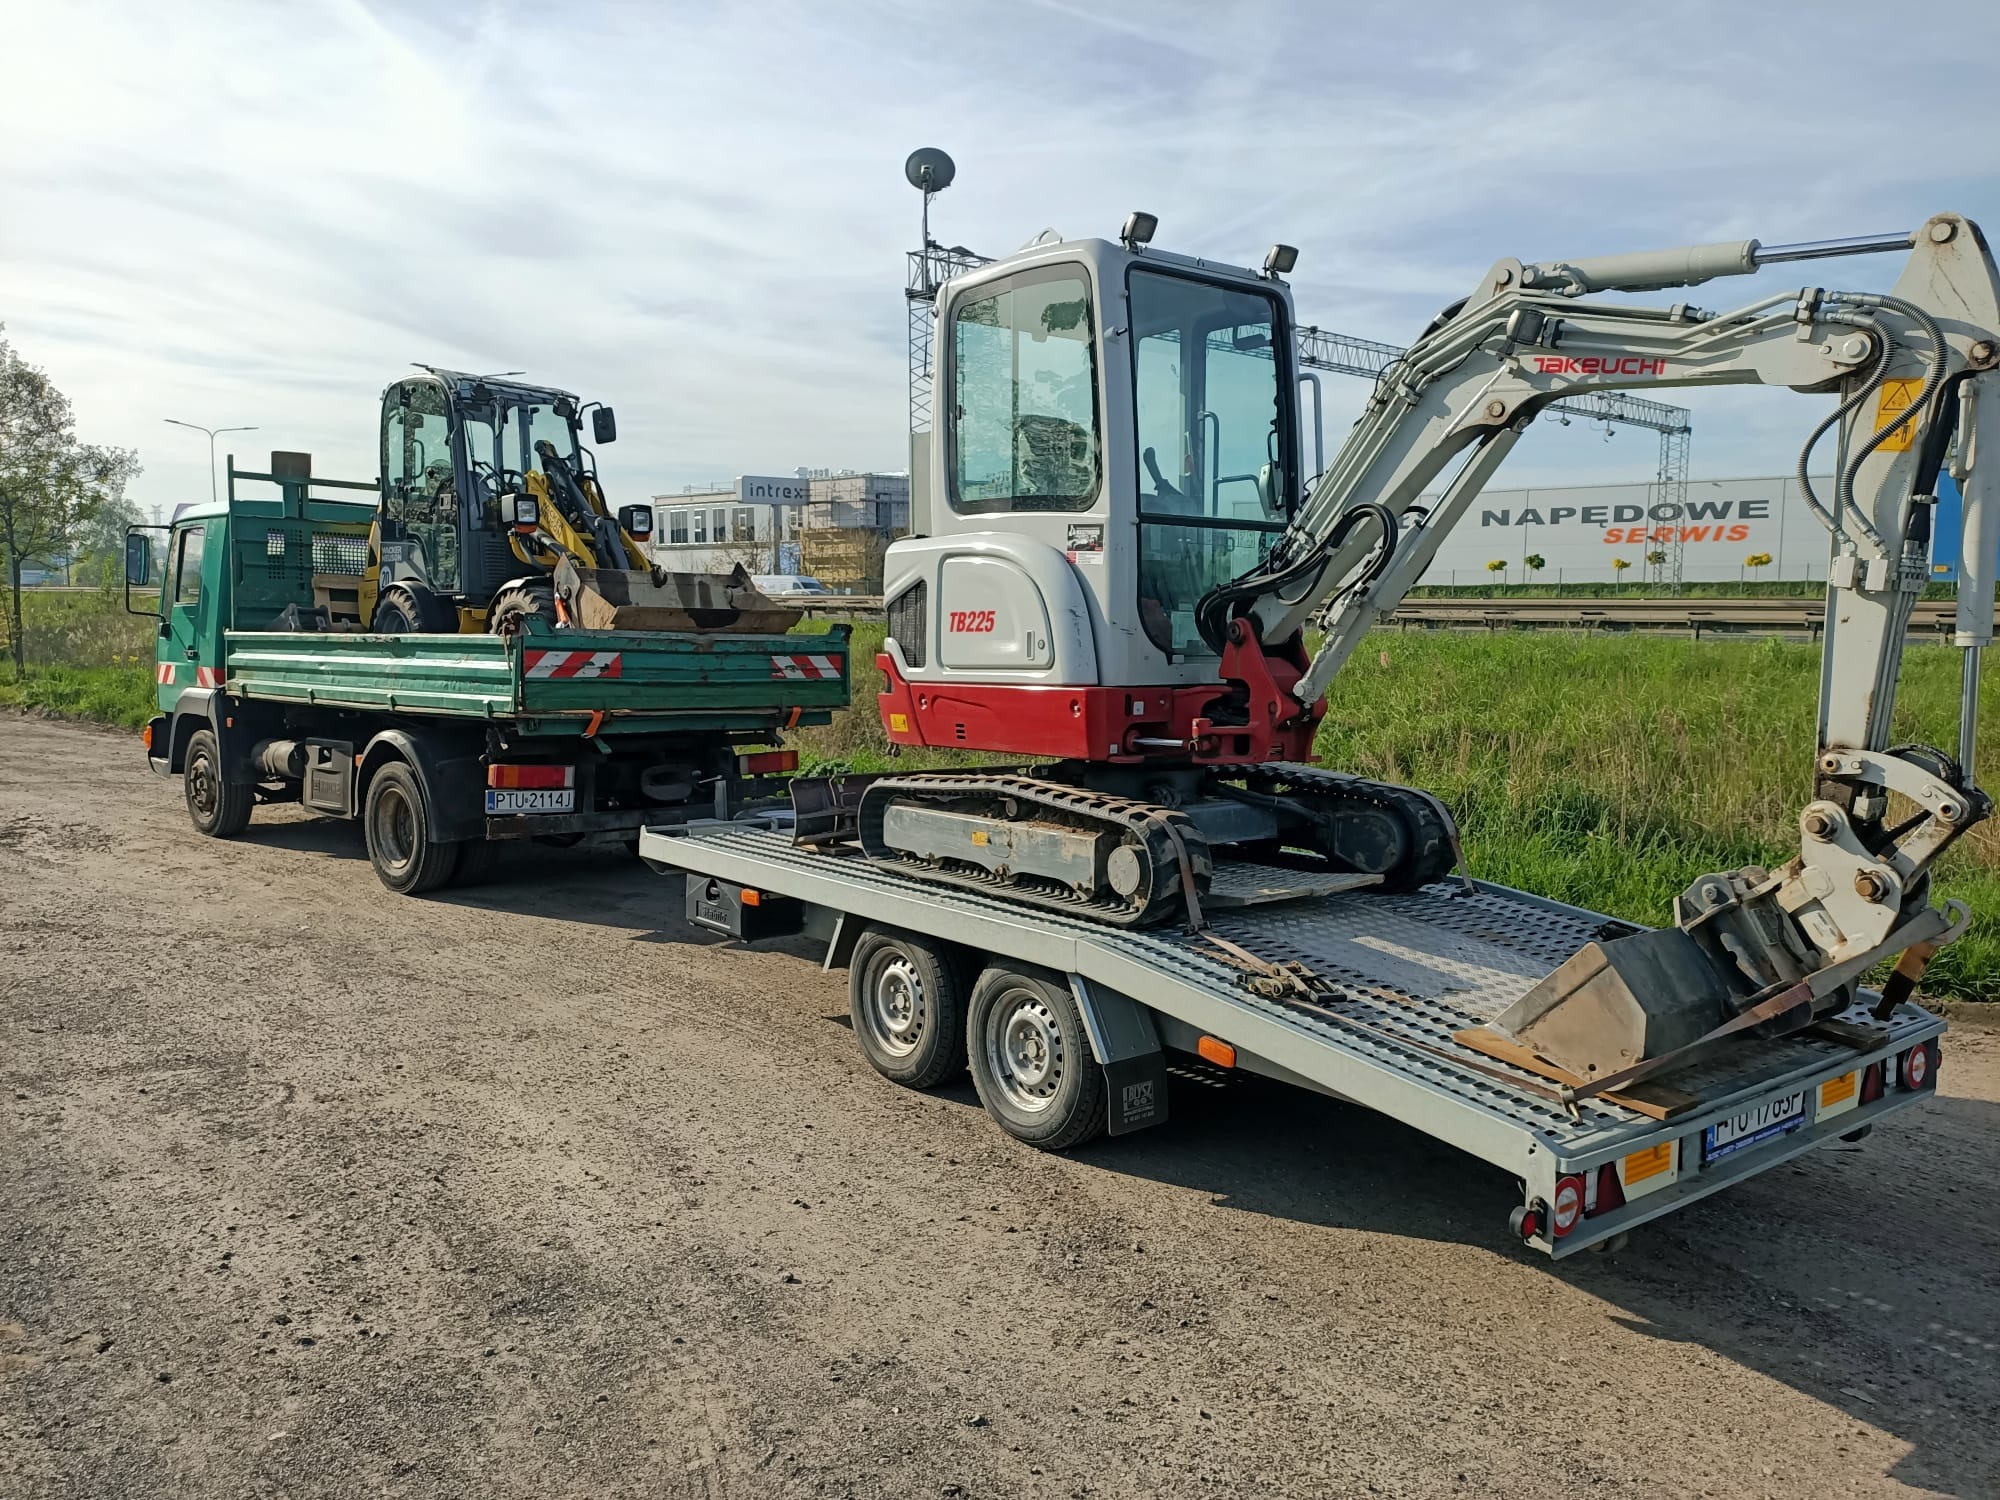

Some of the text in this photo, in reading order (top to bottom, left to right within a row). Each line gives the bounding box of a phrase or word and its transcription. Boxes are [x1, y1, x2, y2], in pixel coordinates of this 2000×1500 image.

[749, 483, 803, 499] intrex
[1481, 500, 1770, 528] NAPĘDOWE
[1602, 525, 1750, 544] SERWIS
[381, 571, 390, 588] 20
[950, 611, 996, 632] TB225
[496, 793, 524, 808] PTU
[529, 793, 571, 808] 2114J
